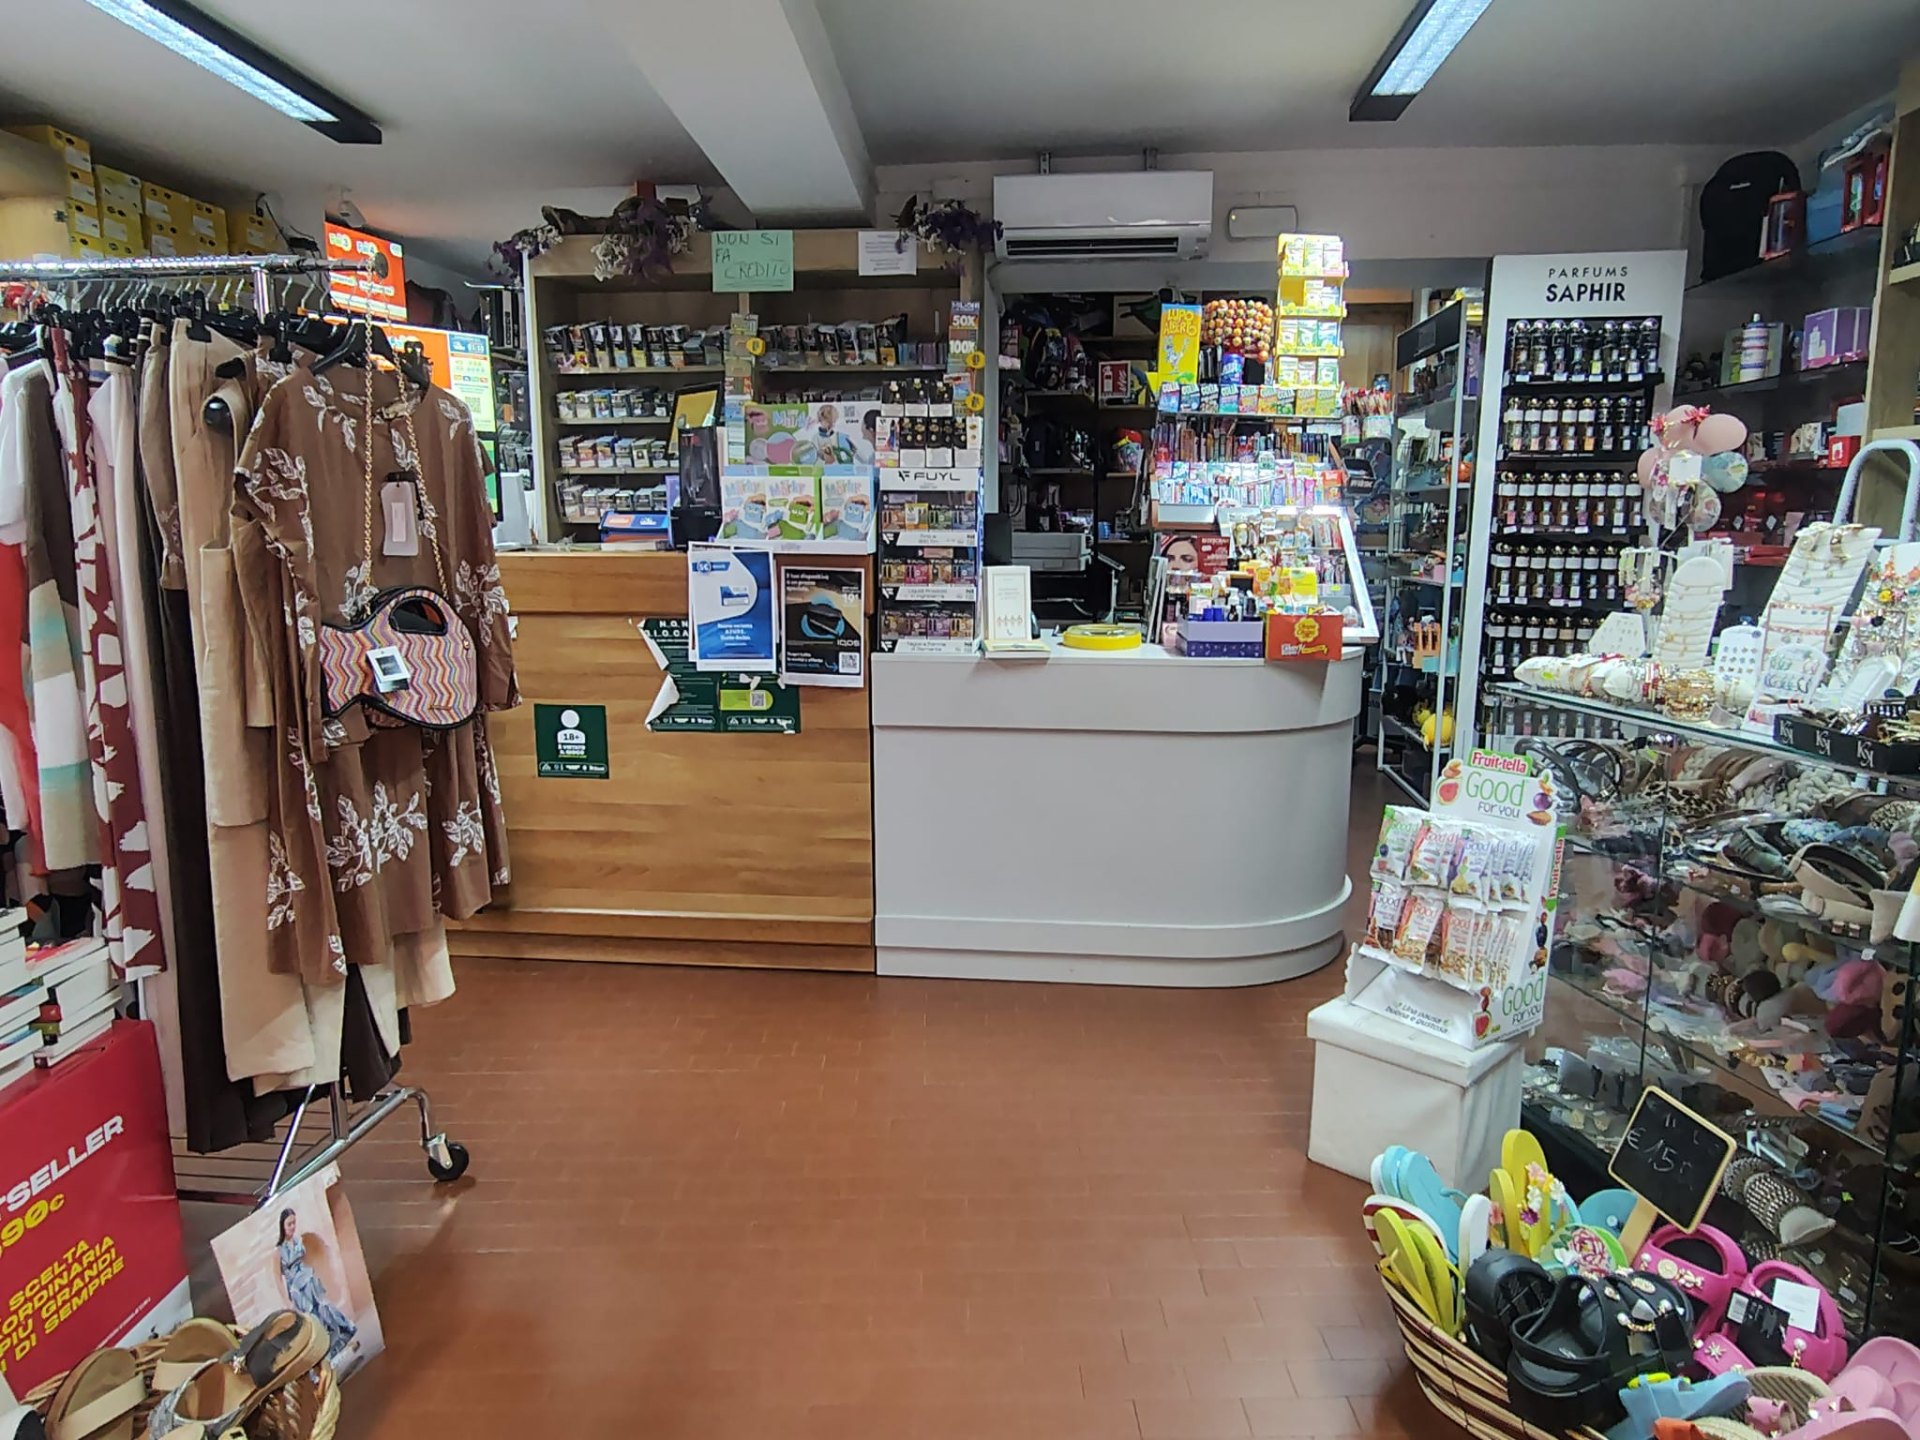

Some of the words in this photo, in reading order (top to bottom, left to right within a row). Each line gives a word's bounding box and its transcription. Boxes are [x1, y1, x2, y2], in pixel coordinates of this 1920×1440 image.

[716, 233, 749, 245] NON
[760, 232, 778, 246] SI
[715, 248, 730, 263] FA
[724, 257, 791, 280] CREDITO
[1549, 266, 1629, 279] PARFUMS
[1546, 282, 1626, 302] SAPHIR
[914, 472, 961, 481] FUYL
[563, 733, 580, 741] 18+
[1472, 752, 1527, 773] Fruit-tella
[9, 1240, 89, 1312] SCELTA
[41, 1247, 116, 1319] GRANDI
[0, 1236, 114, 1340] ORDINARIA
[15, 1332, 37, 1361] DI
[44, 1256, 125, 1335] SEMPRE
